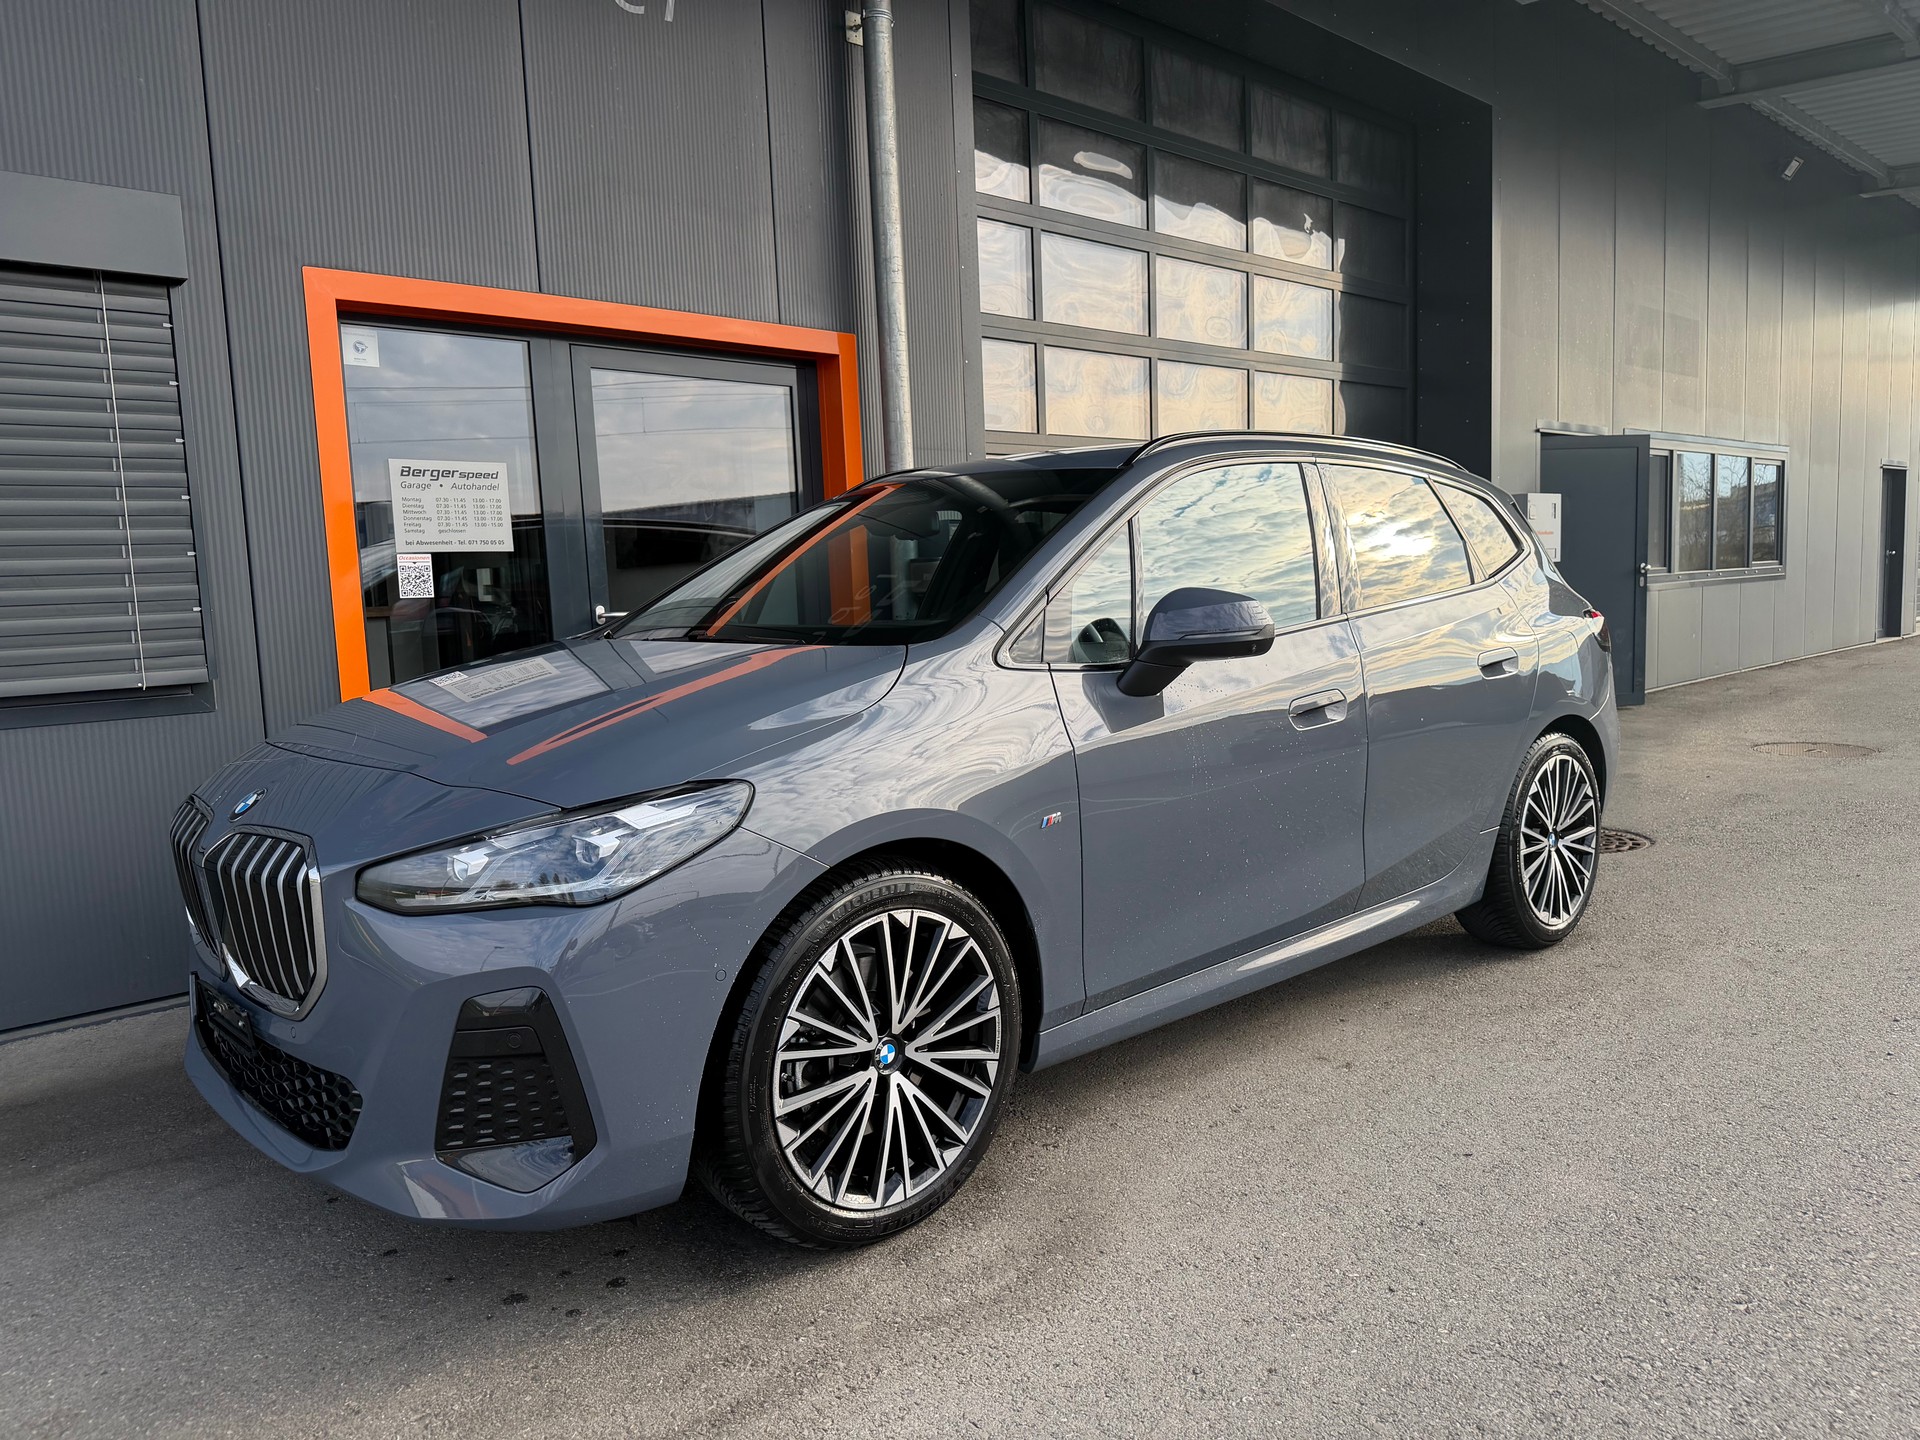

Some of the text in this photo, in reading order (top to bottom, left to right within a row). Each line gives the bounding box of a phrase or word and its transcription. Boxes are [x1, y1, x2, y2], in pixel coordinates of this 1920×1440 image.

[400, 466, 499, 481] Bergerspeed
[400, 481, 500, 491] Garage Autohandel
